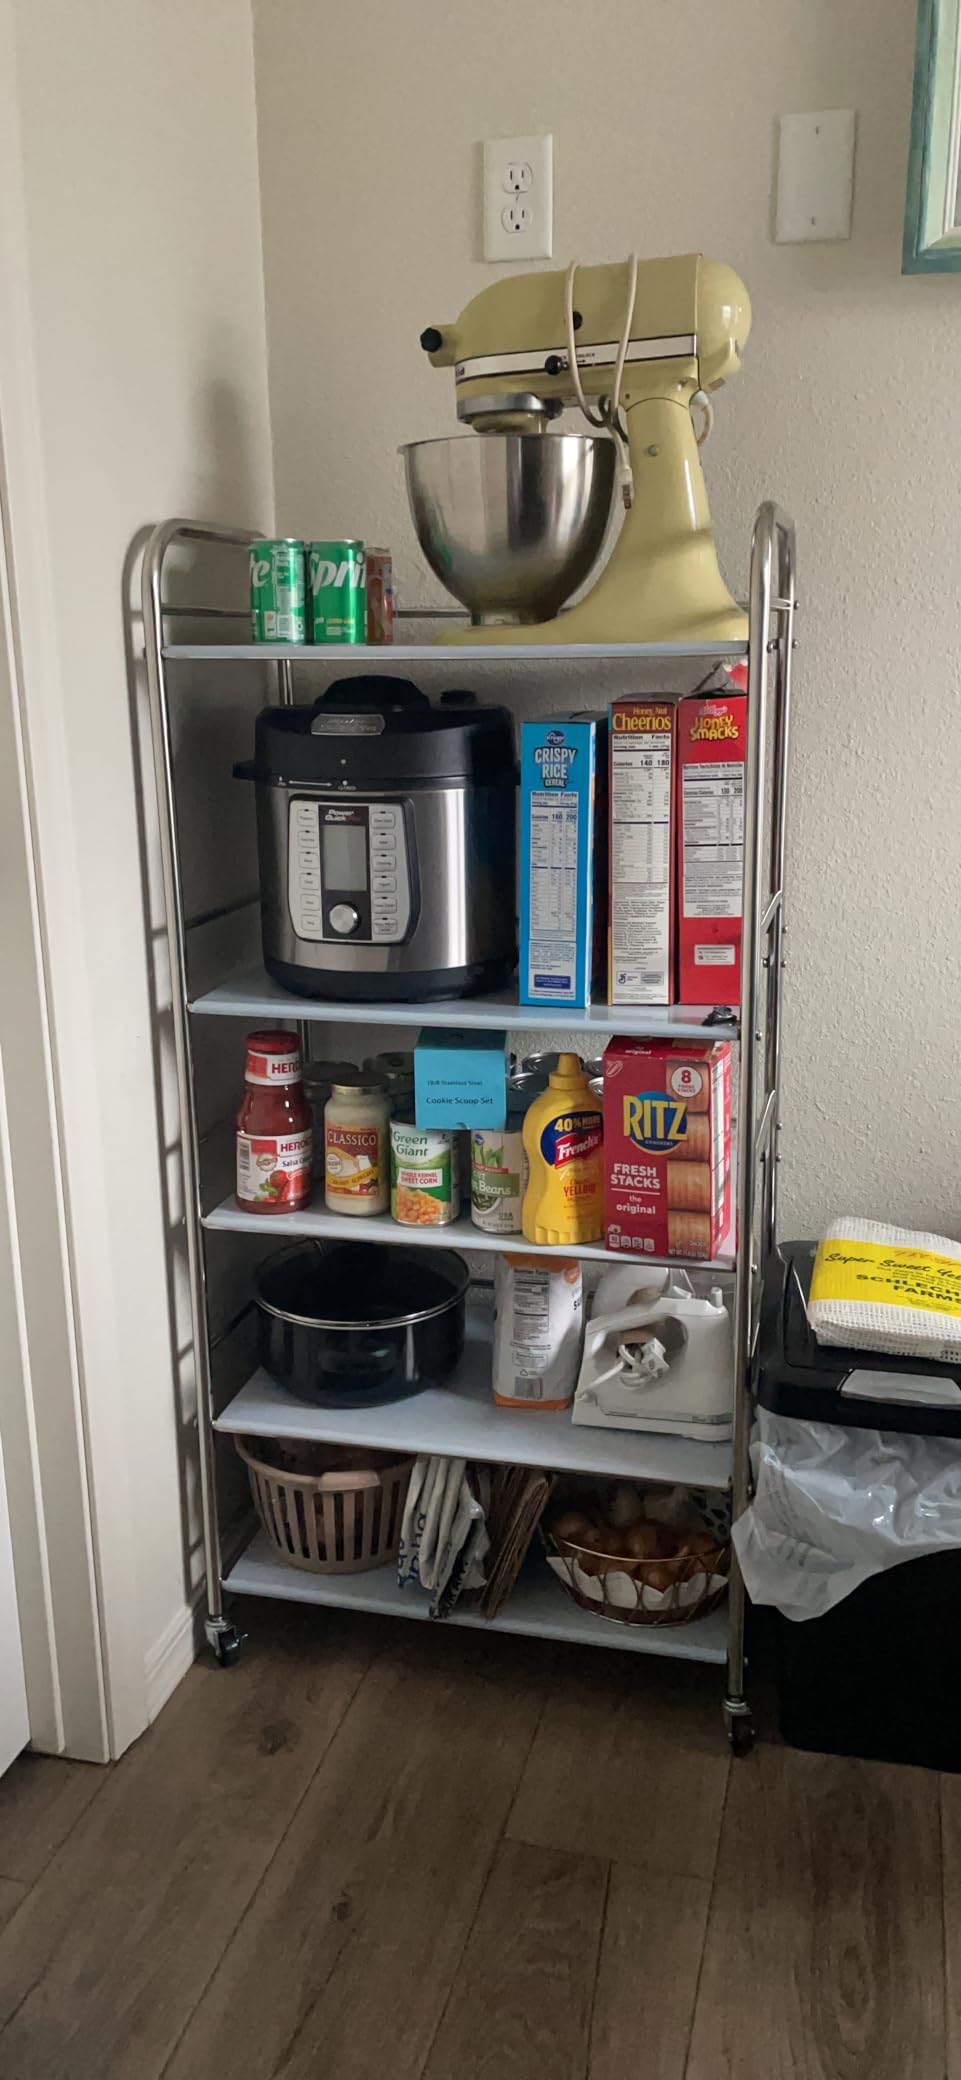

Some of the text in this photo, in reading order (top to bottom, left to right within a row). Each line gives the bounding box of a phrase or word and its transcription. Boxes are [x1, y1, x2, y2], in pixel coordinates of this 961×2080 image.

[633, 706, 668, 716] Honey Nut
[612, 713, 671, 731] Cheerios
[534, 747, 577, 764] CRISPY
[640, 759, 653, 767] 140
[542, 763, 568, 779] RICE
[545, 779, 566, 787] CEREAL
[681, 1069, 692, 1083] 8
[426, 1096, 493, 1106] Cookie Scoop Set
[554, 1117, 582, 1132] 40%
[623, 1095, 688, 1141] RITZ
[327, 1131, 377, 1146] CLASSICO
[393, 1131, 428, 1146] Green
[396, 1143, 429, 1157] Giant
[613, 1163, 657, 1177] FRESH
[419, 1177, 438, 1185] CORN
[478, 1180, 511, 1195] Beans
[610, 1174, 661, 1189] STACKS
[563, 1183, 596, 1197] YELLOW
[629, 1194, 642, 1203] the
[616, 1203, 656, 1215] original
[824, 1252, 876, 1265] Super
[879, 1259, 932, 1272] Sweet
